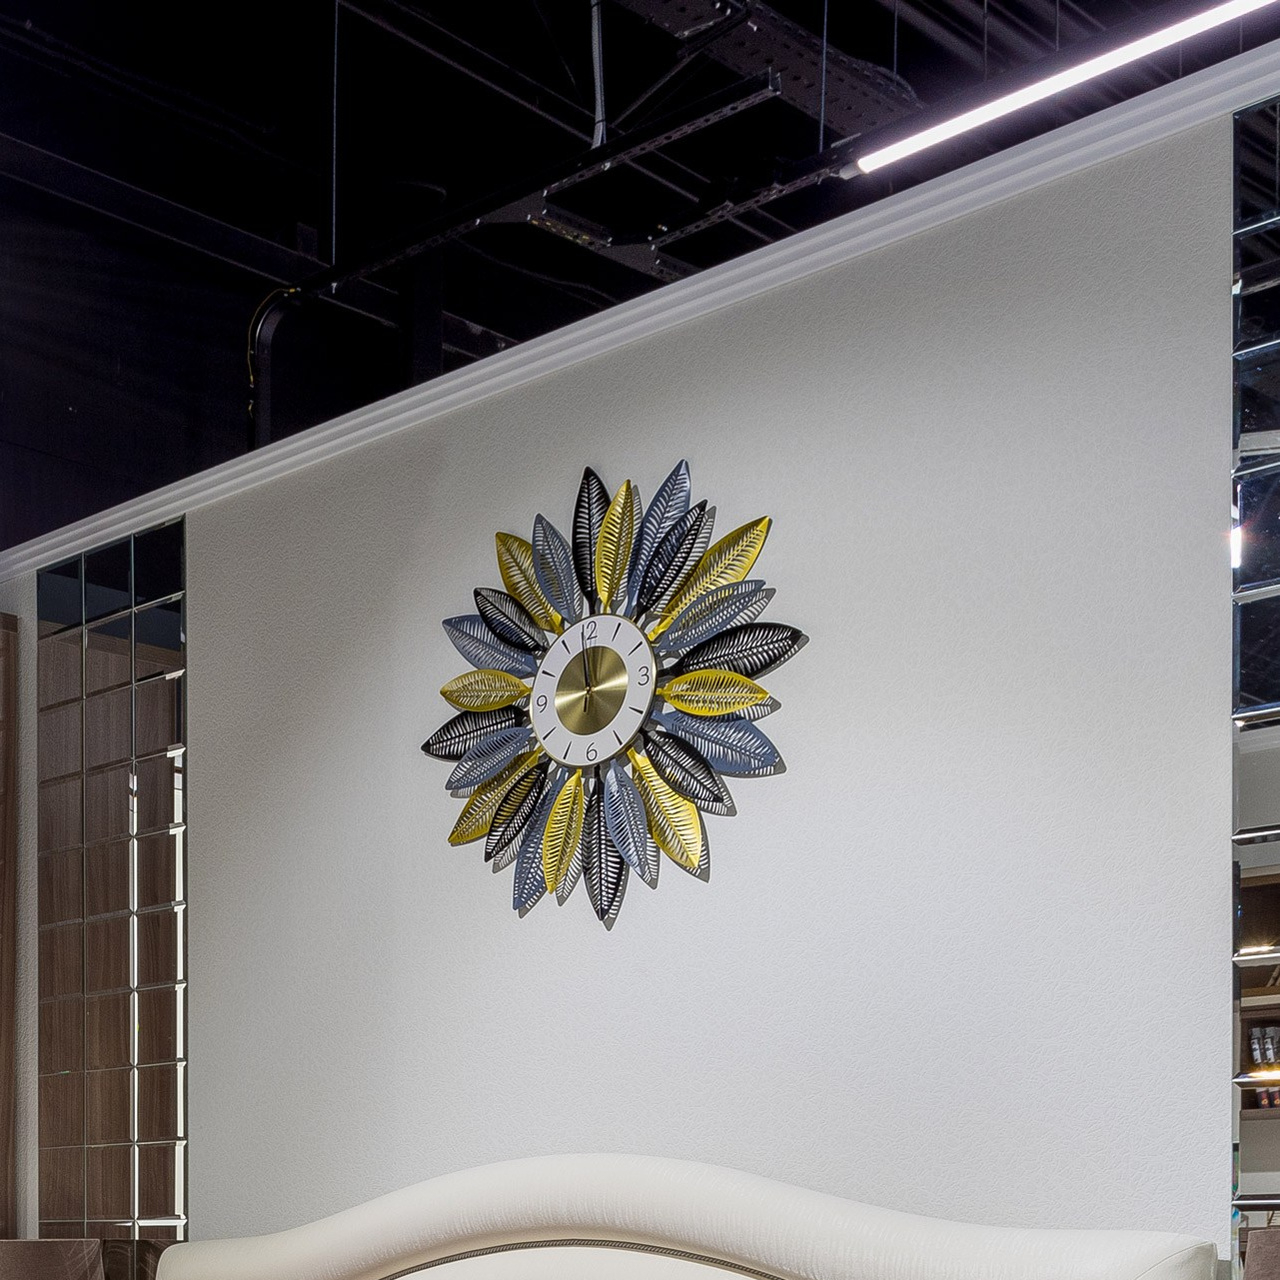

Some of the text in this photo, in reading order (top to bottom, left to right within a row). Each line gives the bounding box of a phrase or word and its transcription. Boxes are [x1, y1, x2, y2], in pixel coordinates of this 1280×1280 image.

[581, 620, 598, 642] 12
[637, 665, 650, 686] 3
[536, 694, 548, 714] 9
[586, 741, 598, 762] 6
